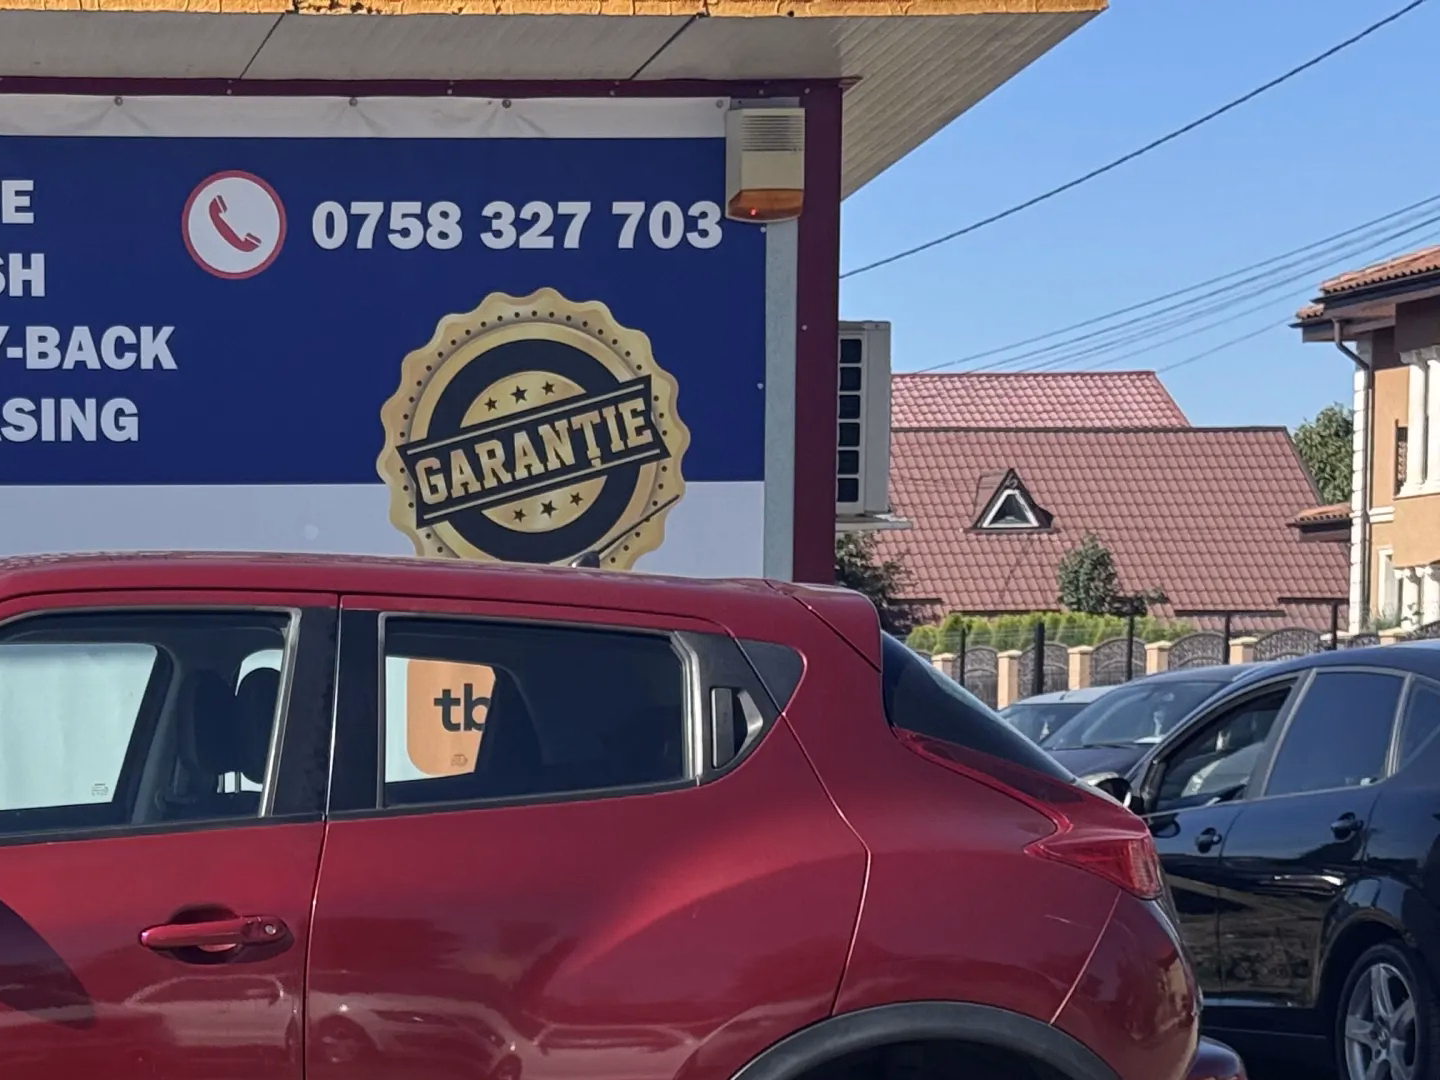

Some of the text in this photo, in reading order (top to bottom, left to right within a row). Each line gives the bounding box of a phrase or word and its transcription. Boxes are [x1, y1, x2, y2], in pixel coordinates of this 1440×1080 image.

[311, 199, 724, 251] 0758 327 703
